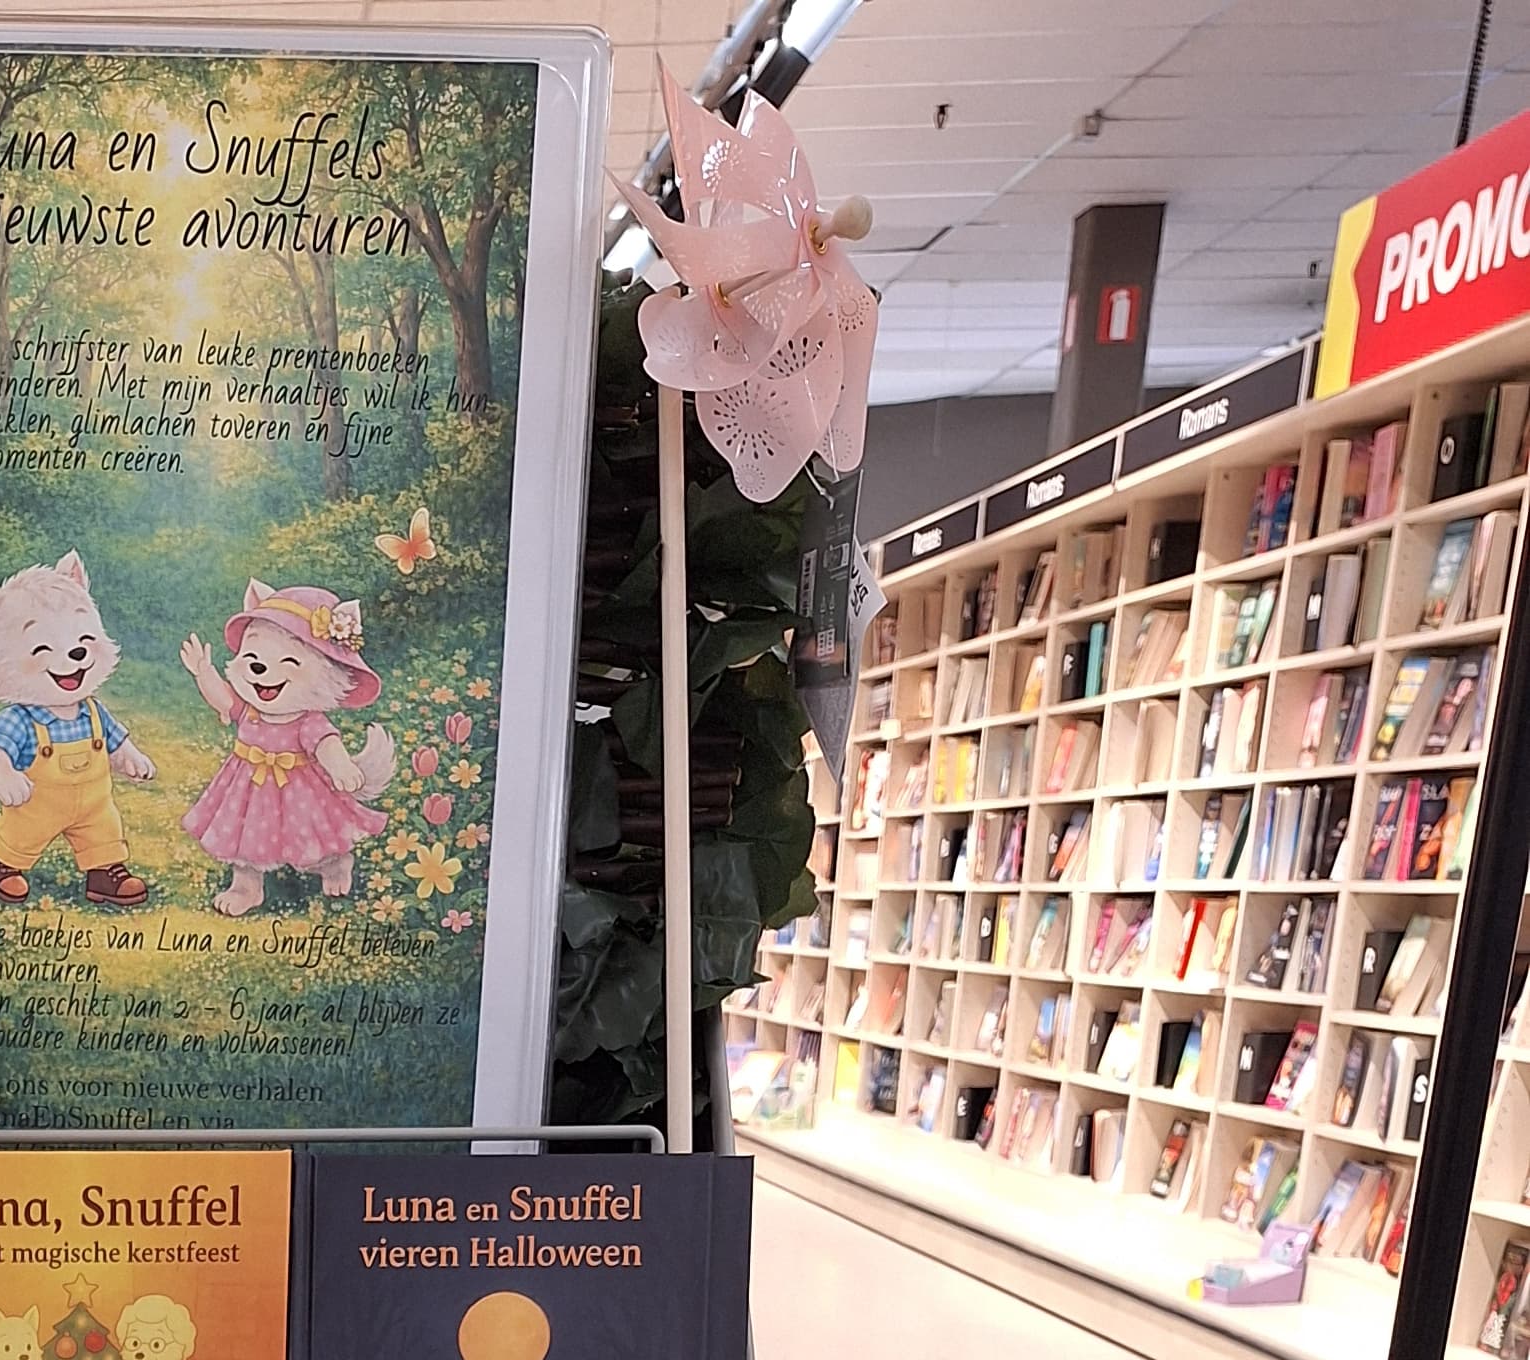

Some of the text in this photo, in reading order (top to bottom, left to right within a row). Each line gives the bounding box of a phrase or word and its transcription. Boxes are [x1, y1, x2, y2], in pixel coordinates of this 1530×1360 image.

[108, 131, 157, 173] en
[185, 100, 387, 206] Snuffels
[183, 200, 412, 258] avonturen
[12, 325, 130, 375] schrijfster
[143, 337, 183, 363] van
[198, 329, 255, 366] leuke
[269, 336, 429, 378] prentenboeken
[98, 363, 147, 400] Met
[163, 376, 212, 415] mijn
[227, 370, 349, 420] verhaaltjes
[364, 374, 397, 410] wil
[411, 377, 432, 411] ik
[446, 377, 489, 412] hun
[68, 400, 196, 448] glimlachen
[210, 413, 290, 441] toveren
[304, 423, 329, 443] en
[328, 412, 394, 459] fijne
[1179, 398, 1230, 441] Romans
[101, 445, 185, 474] creëren.
[20, 910, 92, 961] boekjes
[107, 922, 144, 949] van
[157, 917, 212, 953] Luna
[226, 933, 249, 953] en
[262, 919, 348, 969] Snuffel
[360, 925, 435, 958] beleven
[24, 983, 111, 1027] geschikt
[123, 993, 161, 1018] van
[174, 1001, 189, 1018] 2
[230, 986, 248, 1021] 6
[246, 1000, 308, 1034] jaar,
[322, 991, 343, 1023] al
[358, 991, 423, 1037] blijven
[436, 1005, 460, 1025] ze
[77, 1018, 168, 1054] kinderen
[181, 1032, 205, 1052] en
[219, 1020, 356, 1058] volwassenen!
[6, 1078, 323, 1102] ons voor nieuwe verhalen
[1413, 1074, 1429, 1103] S
[163, 1112, 235, 1129] en via
[81, 1186, 241, 1229] Snuffel
[362, 1184, 642, 1223] Luna en Snuffel
[11, 1242, 121, 1268] magische
[127, 1242, 240, 1263] kerstfeest
[360, 1237, 642, 1269] vieren Halloween
